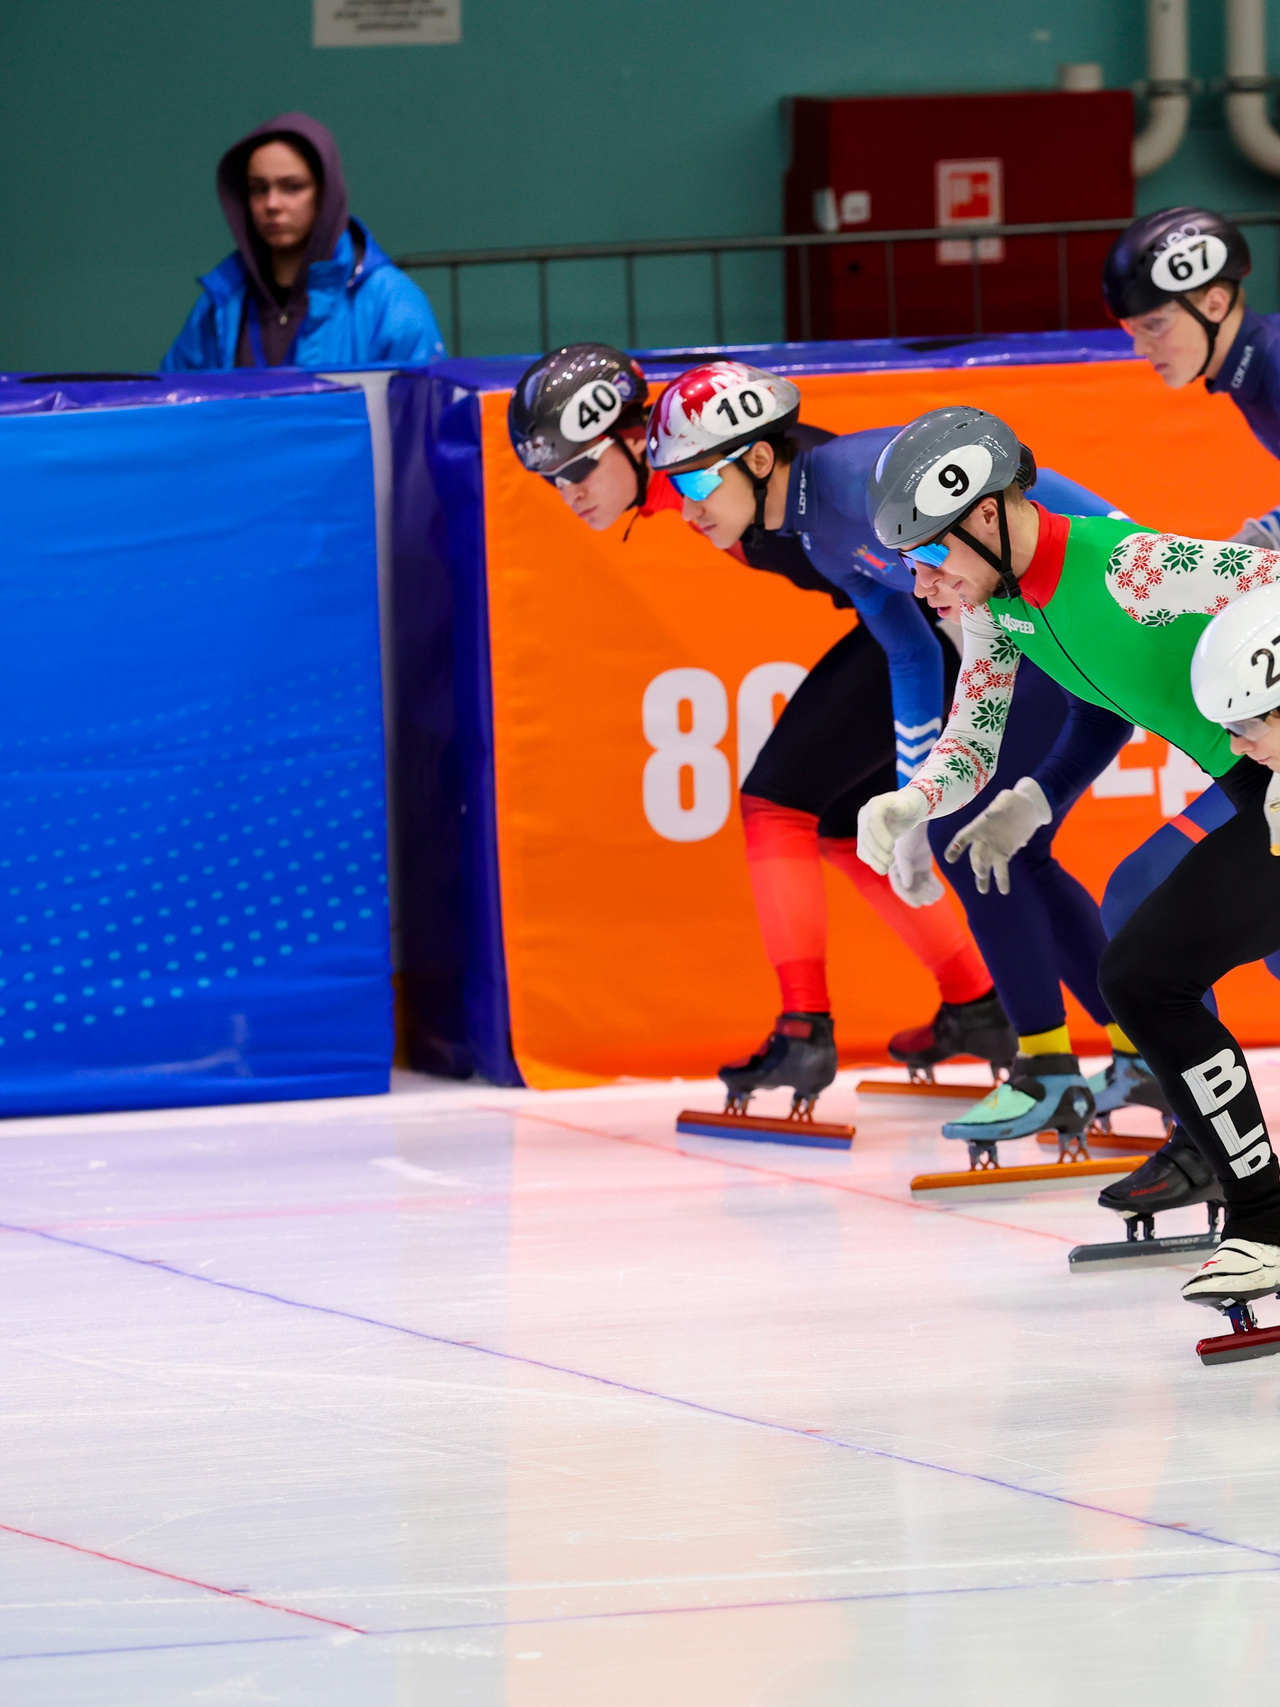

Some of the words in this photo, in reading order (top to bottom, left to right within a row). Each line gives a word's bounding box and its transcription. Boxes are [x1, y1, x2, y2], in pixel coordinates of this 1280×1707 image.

[1167, 240, 1210, 281] 67
[578, 383, 618, 430] 40
[716, 389, 764, 426] 10
[938, 464, 970, 497] 9
